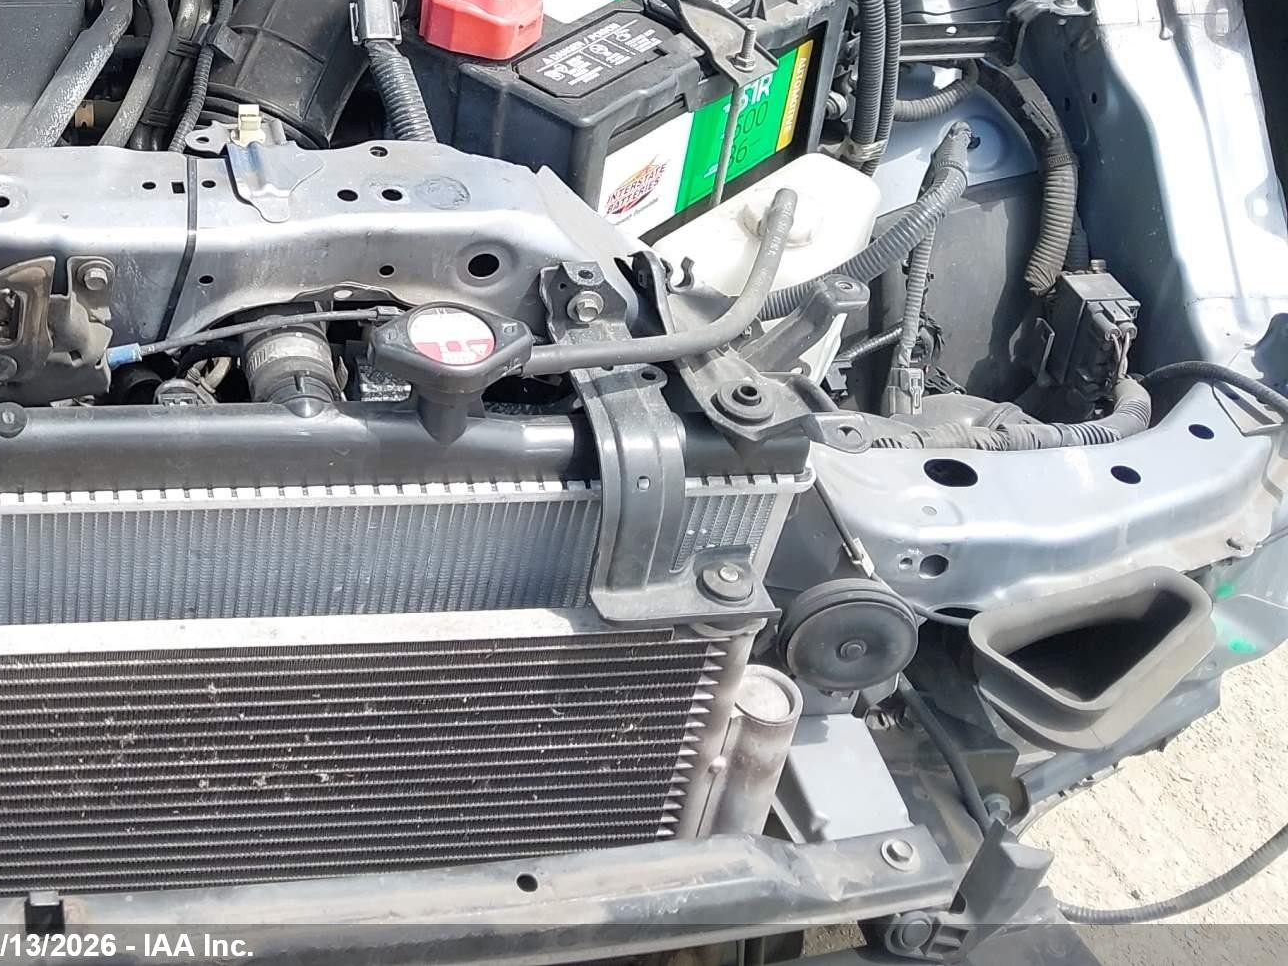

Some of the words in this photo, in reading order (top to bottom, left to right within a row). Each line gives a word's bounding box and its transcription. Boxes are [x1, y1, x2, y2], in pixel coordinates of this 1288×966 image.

[785, 57, 807, 132] AUTOMOTIVE
[606, 177, 660, 215] BATTERIES
[607, 163, 667, 205] INTERSTATE
